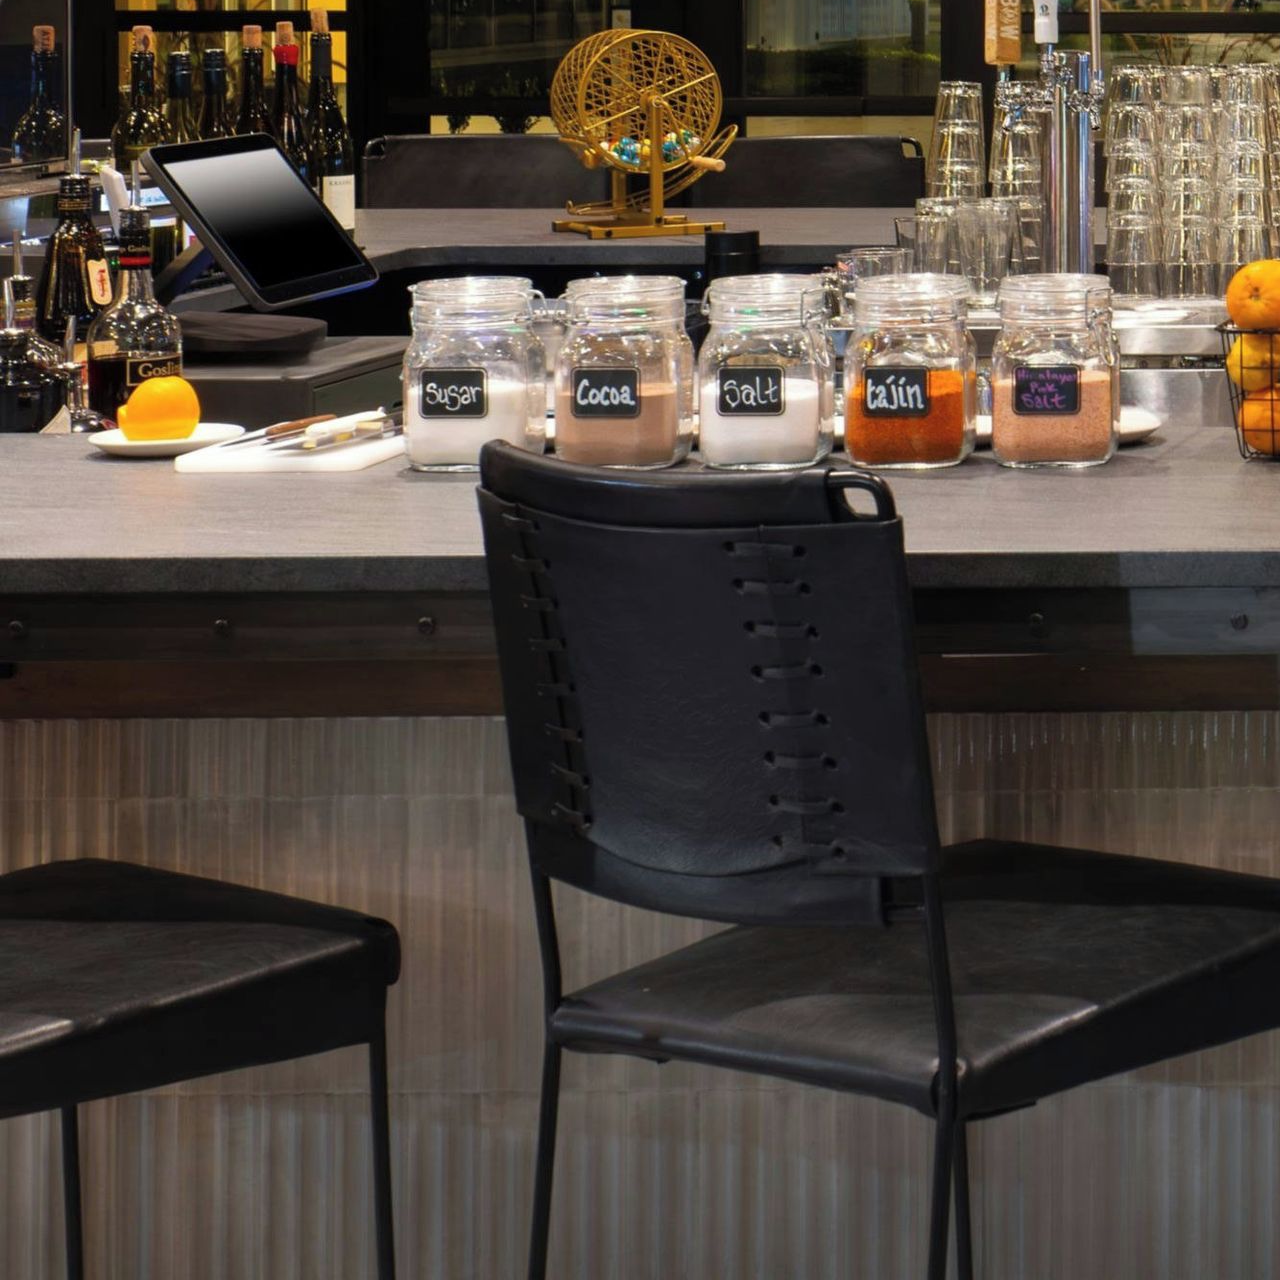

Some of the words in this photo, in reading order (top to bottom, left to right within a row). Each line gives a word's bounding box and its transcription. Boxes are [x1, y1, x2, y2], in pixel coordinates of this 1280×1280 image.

[425, 382, 483, 411] Sugar
[575, 378, 636, 406] Cocoa
[723, 376, 779, 408] Salt
[1021, 393, 1066, 409] Salt
